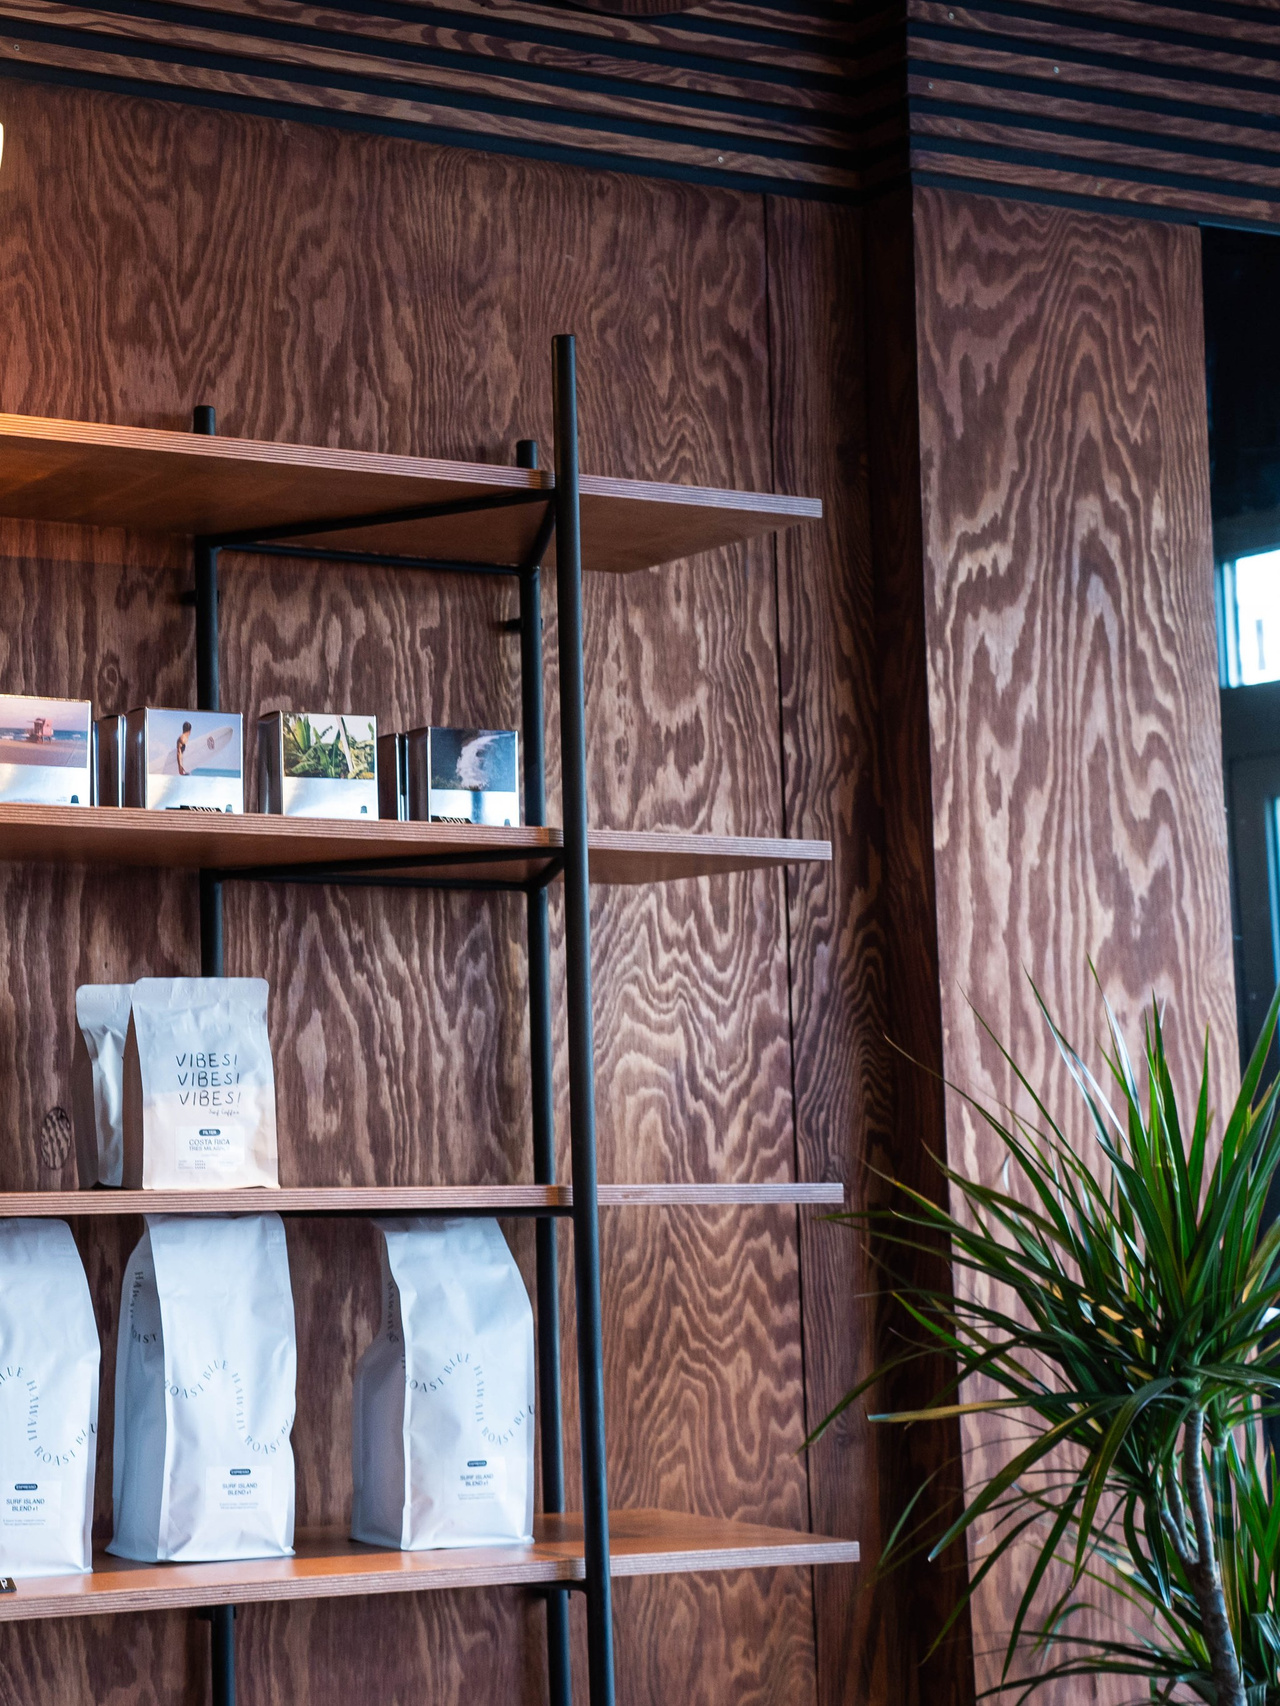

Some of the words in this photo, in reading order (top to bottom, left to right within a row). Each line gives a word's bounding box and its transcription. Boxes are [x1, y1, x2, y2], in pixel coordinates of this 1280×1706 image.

[175, 1052, 238, 1070] VIBES!
[177, 1071, 240, 1088] VIBES!
[179, 1090, 241, 1107] VIBES!
[26, 1380, 40, 1441] HAWAII
[34, 1446, 76, 1466] ROAST
[203, 1359, 229, 1381] BLUE
[231, 1373, 245, 1430] HAWAII
[244, 1435, 280, 1455] ROAST
[443, 1353, 471, 1375] BLUE
[473, 1365, 485, 1422] HAWAII
[482, 1426, 515, 1446] ROAST
